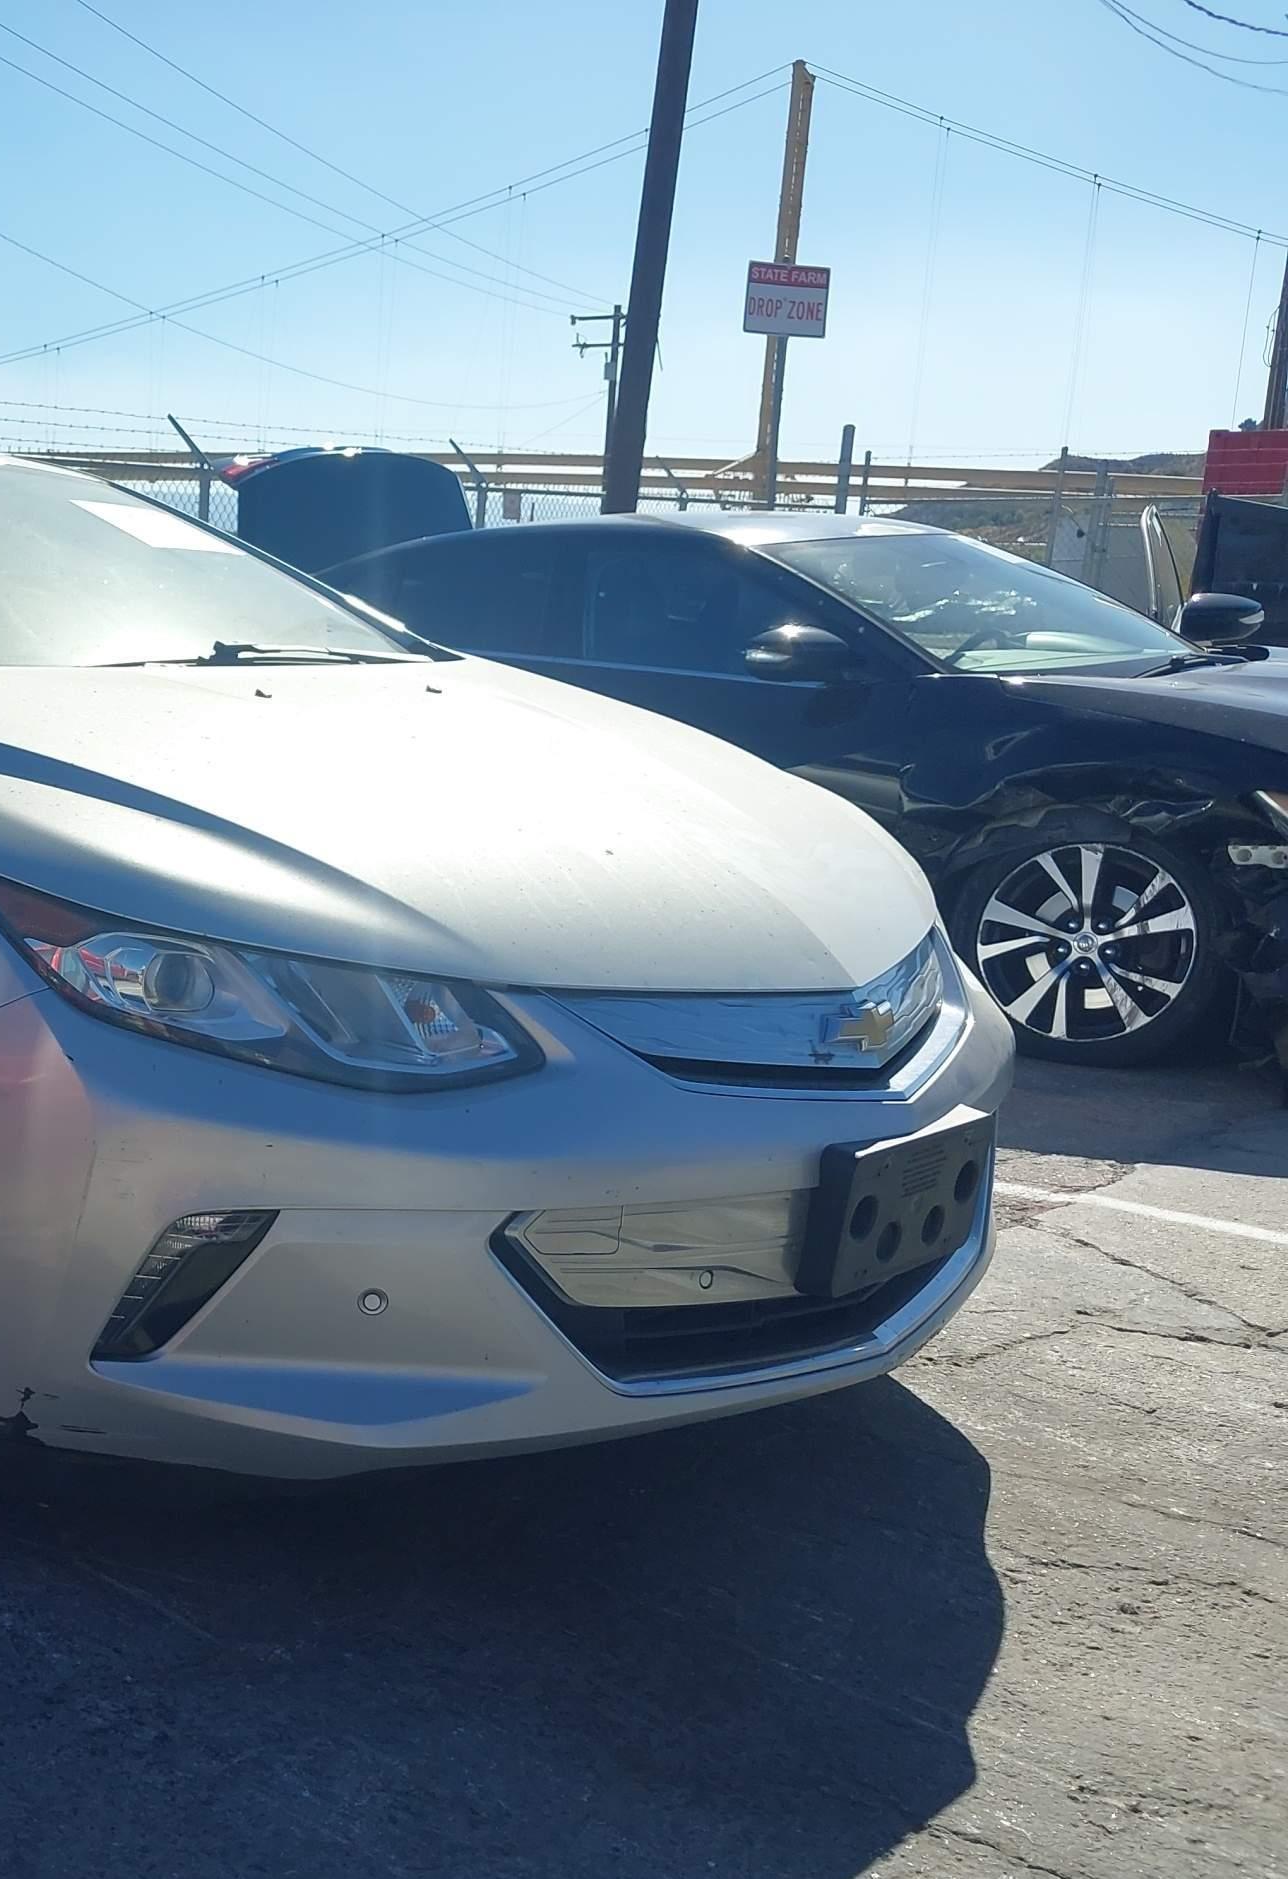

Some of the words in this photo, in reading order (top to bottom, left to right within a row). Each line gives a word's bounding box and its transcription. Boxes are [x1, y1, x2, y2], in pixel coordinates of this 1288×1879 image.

[751, 266, 789, 282] STATE
[791, 270, 827, 286] FARM
[747, 296, 783, 319] DROP
[787, 300, 824, 321] ZONE
